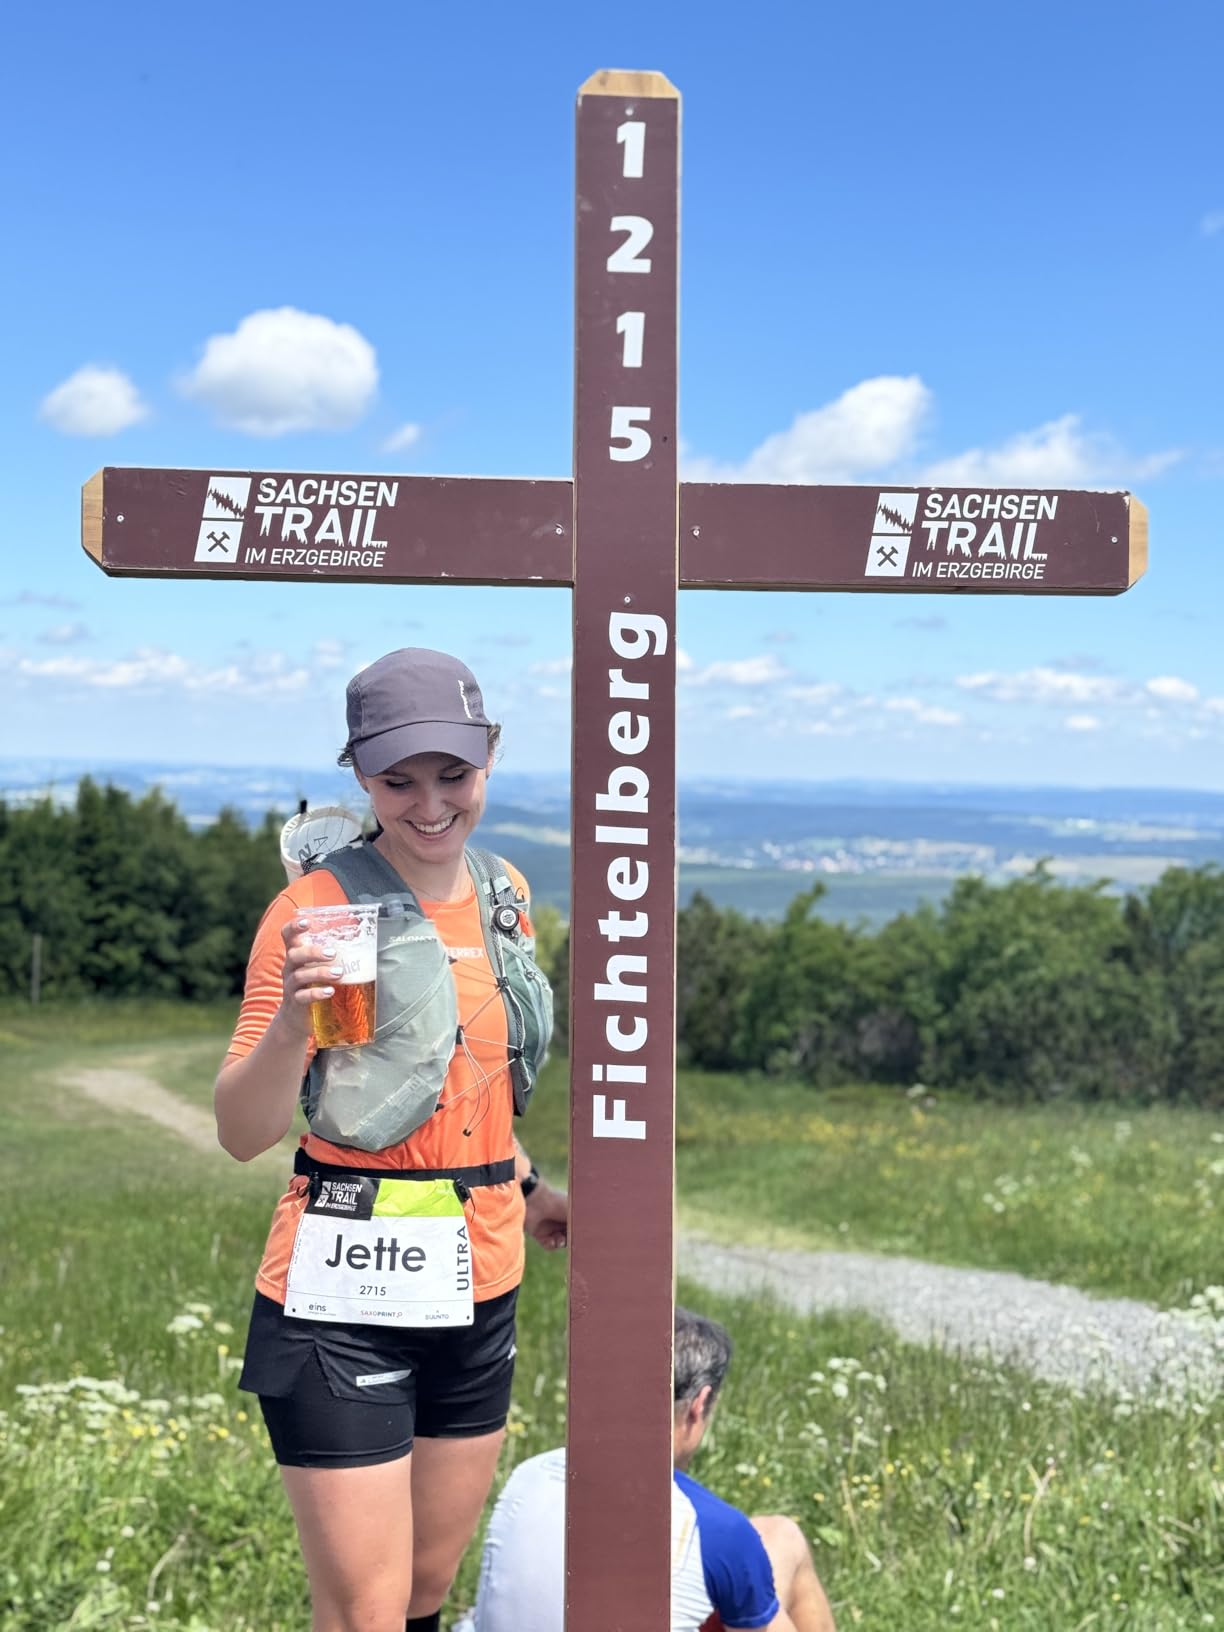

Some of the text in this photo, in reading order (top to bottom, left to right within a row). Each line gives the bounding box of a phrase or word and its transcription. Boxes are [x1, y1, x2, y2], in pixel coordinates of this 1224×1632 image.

[606, 121, 654, 462] 1215
[257, 477, 399, 507] SACHSEN
[924, 493, 1059, 520] SACHSEN
[254, 506, 388, 548] TRAIL
[921, 521, 1048, 561] TRAIL
[244, 547, 386, 568] IM ERZGEBIRGE
[912, 561, 1046, 580] IM ERZGEBIRGE
[592, 611, 668, 1140] Fichtelberg
[330, 1190, 358, 1205] TRAIL
[331, 1182, 363, 1193] SACHSEN
[325, 1234, 426, 1272] Jette
[456, 1225, 470, 1291] ULTRA
[359, 1285, 386, 1296] 2715
[308, 1302, 327, 1312] eins
